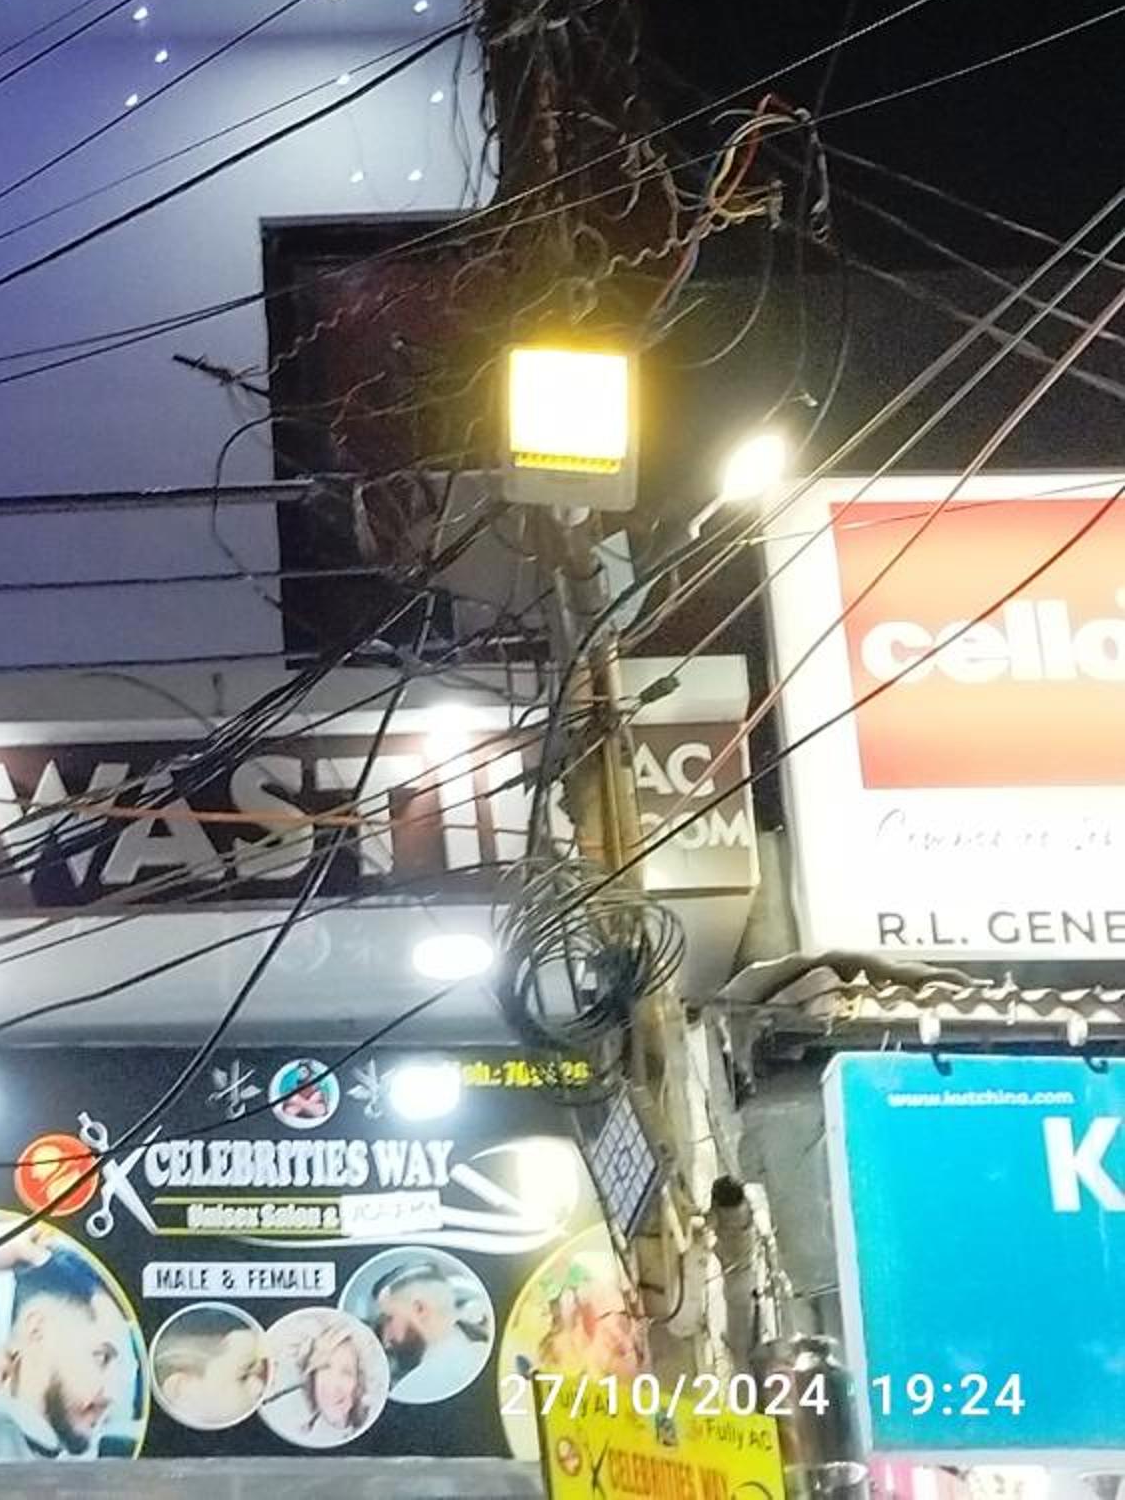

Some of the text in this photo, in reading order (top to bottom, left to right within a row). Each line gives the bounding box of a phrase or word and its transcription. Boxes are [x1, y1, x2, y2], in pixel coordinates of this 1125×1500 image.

[635, 743, 715, 797] AC
[878, 910, 1125, 945] R.L. GENE
[144, 1139, 453, 1188] CELEBRITIES WAY
[156, 1268, 324, 1289] MALE & FEMALE
[706, 1418, 743, 1450] Fully
